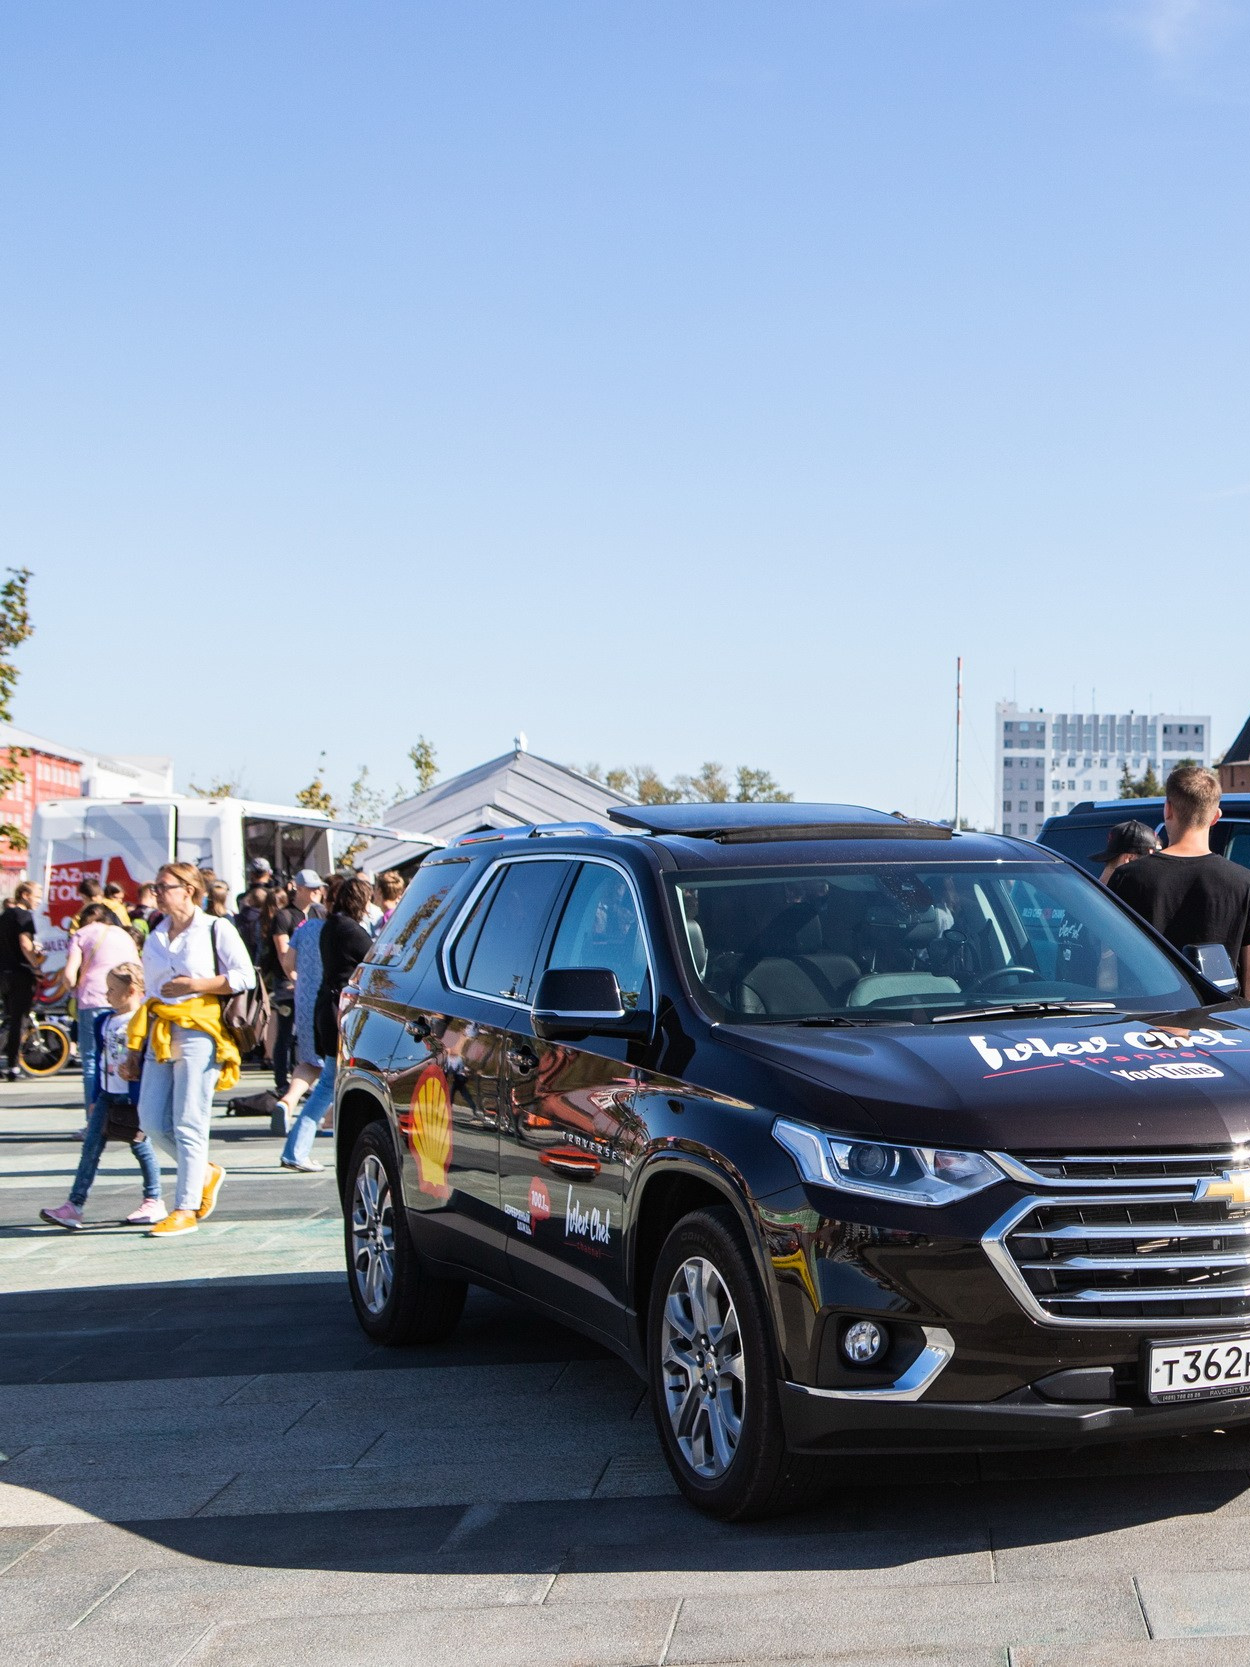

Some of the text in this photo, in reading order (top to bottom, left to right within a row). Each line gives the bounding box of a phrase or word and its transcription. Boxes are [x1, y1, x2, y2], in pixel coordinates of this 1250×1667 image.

[49, 884, 82, 901] TOU
[1069, 1049, 1211, 1067] channel
[1110, 1062, 1223, 1082] YouTube
[562, 1131, 619, 1160] TRAVERSE
[1209, 1387, 1239, 1397] FAVORIT
